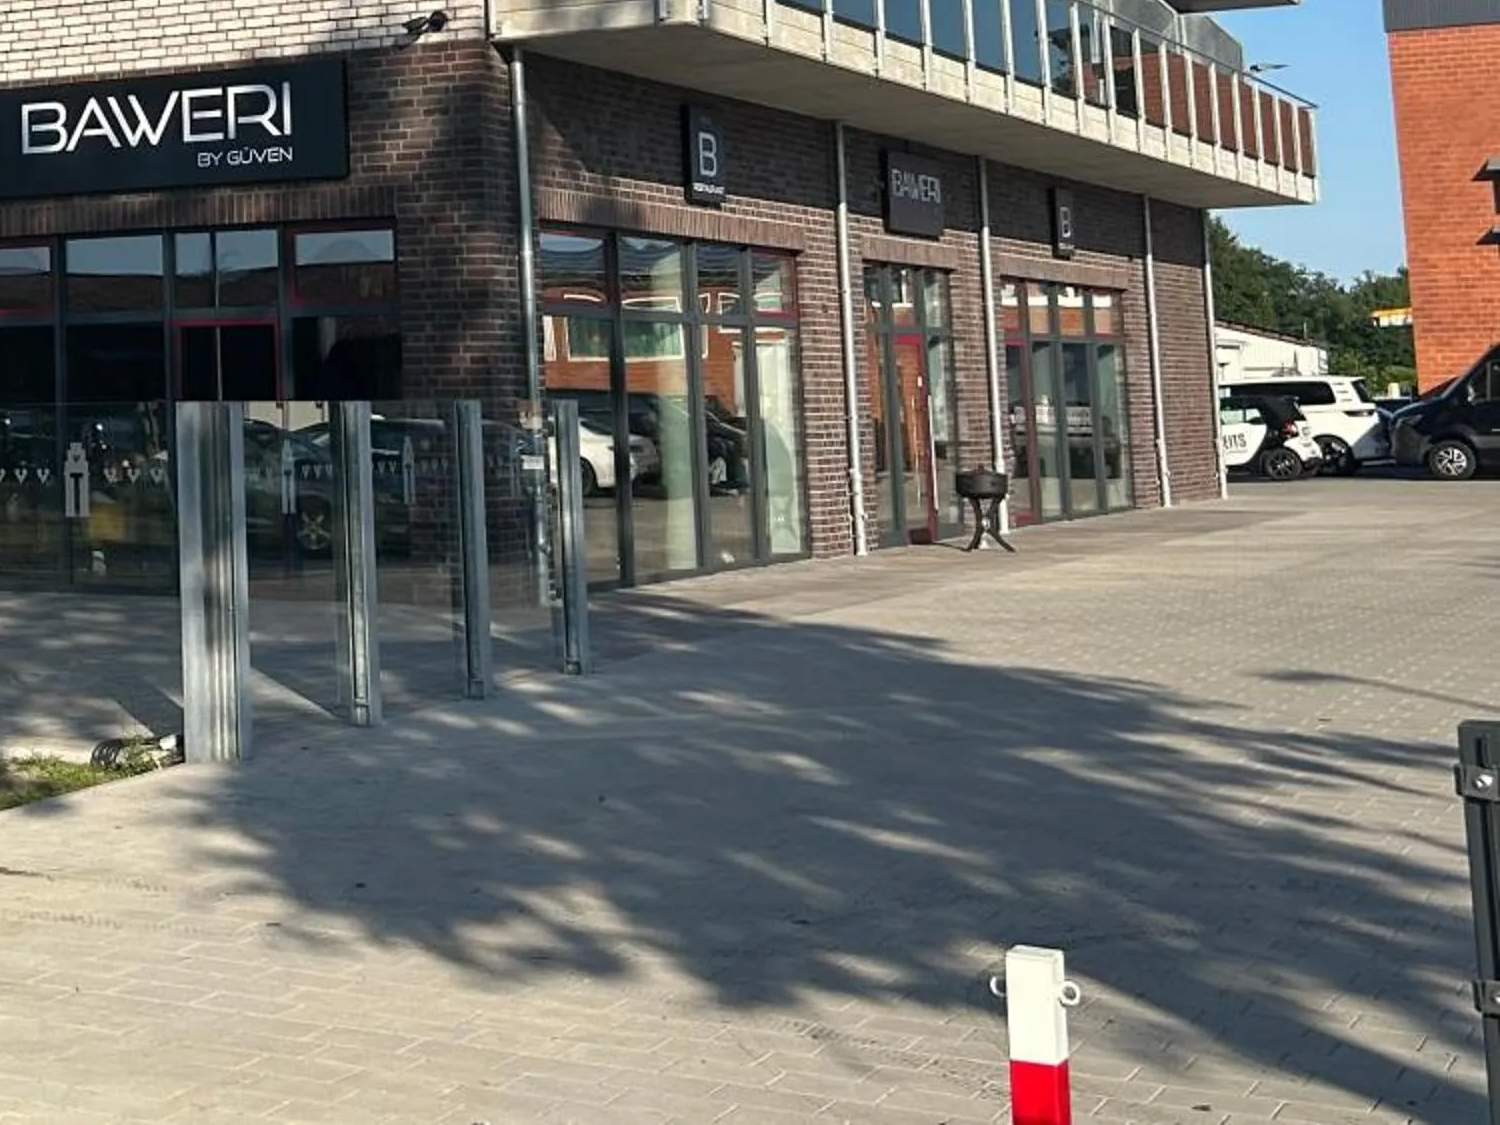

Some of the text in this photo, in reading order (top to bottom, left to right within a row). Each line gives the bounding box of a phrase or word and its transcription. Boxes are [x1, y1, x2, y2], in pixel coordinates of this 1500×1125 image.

[20, 81, 293, 156] BAWERI
[197, 146, 293, 168] BY GÜVEN
[698, 130, 717, 177] B
